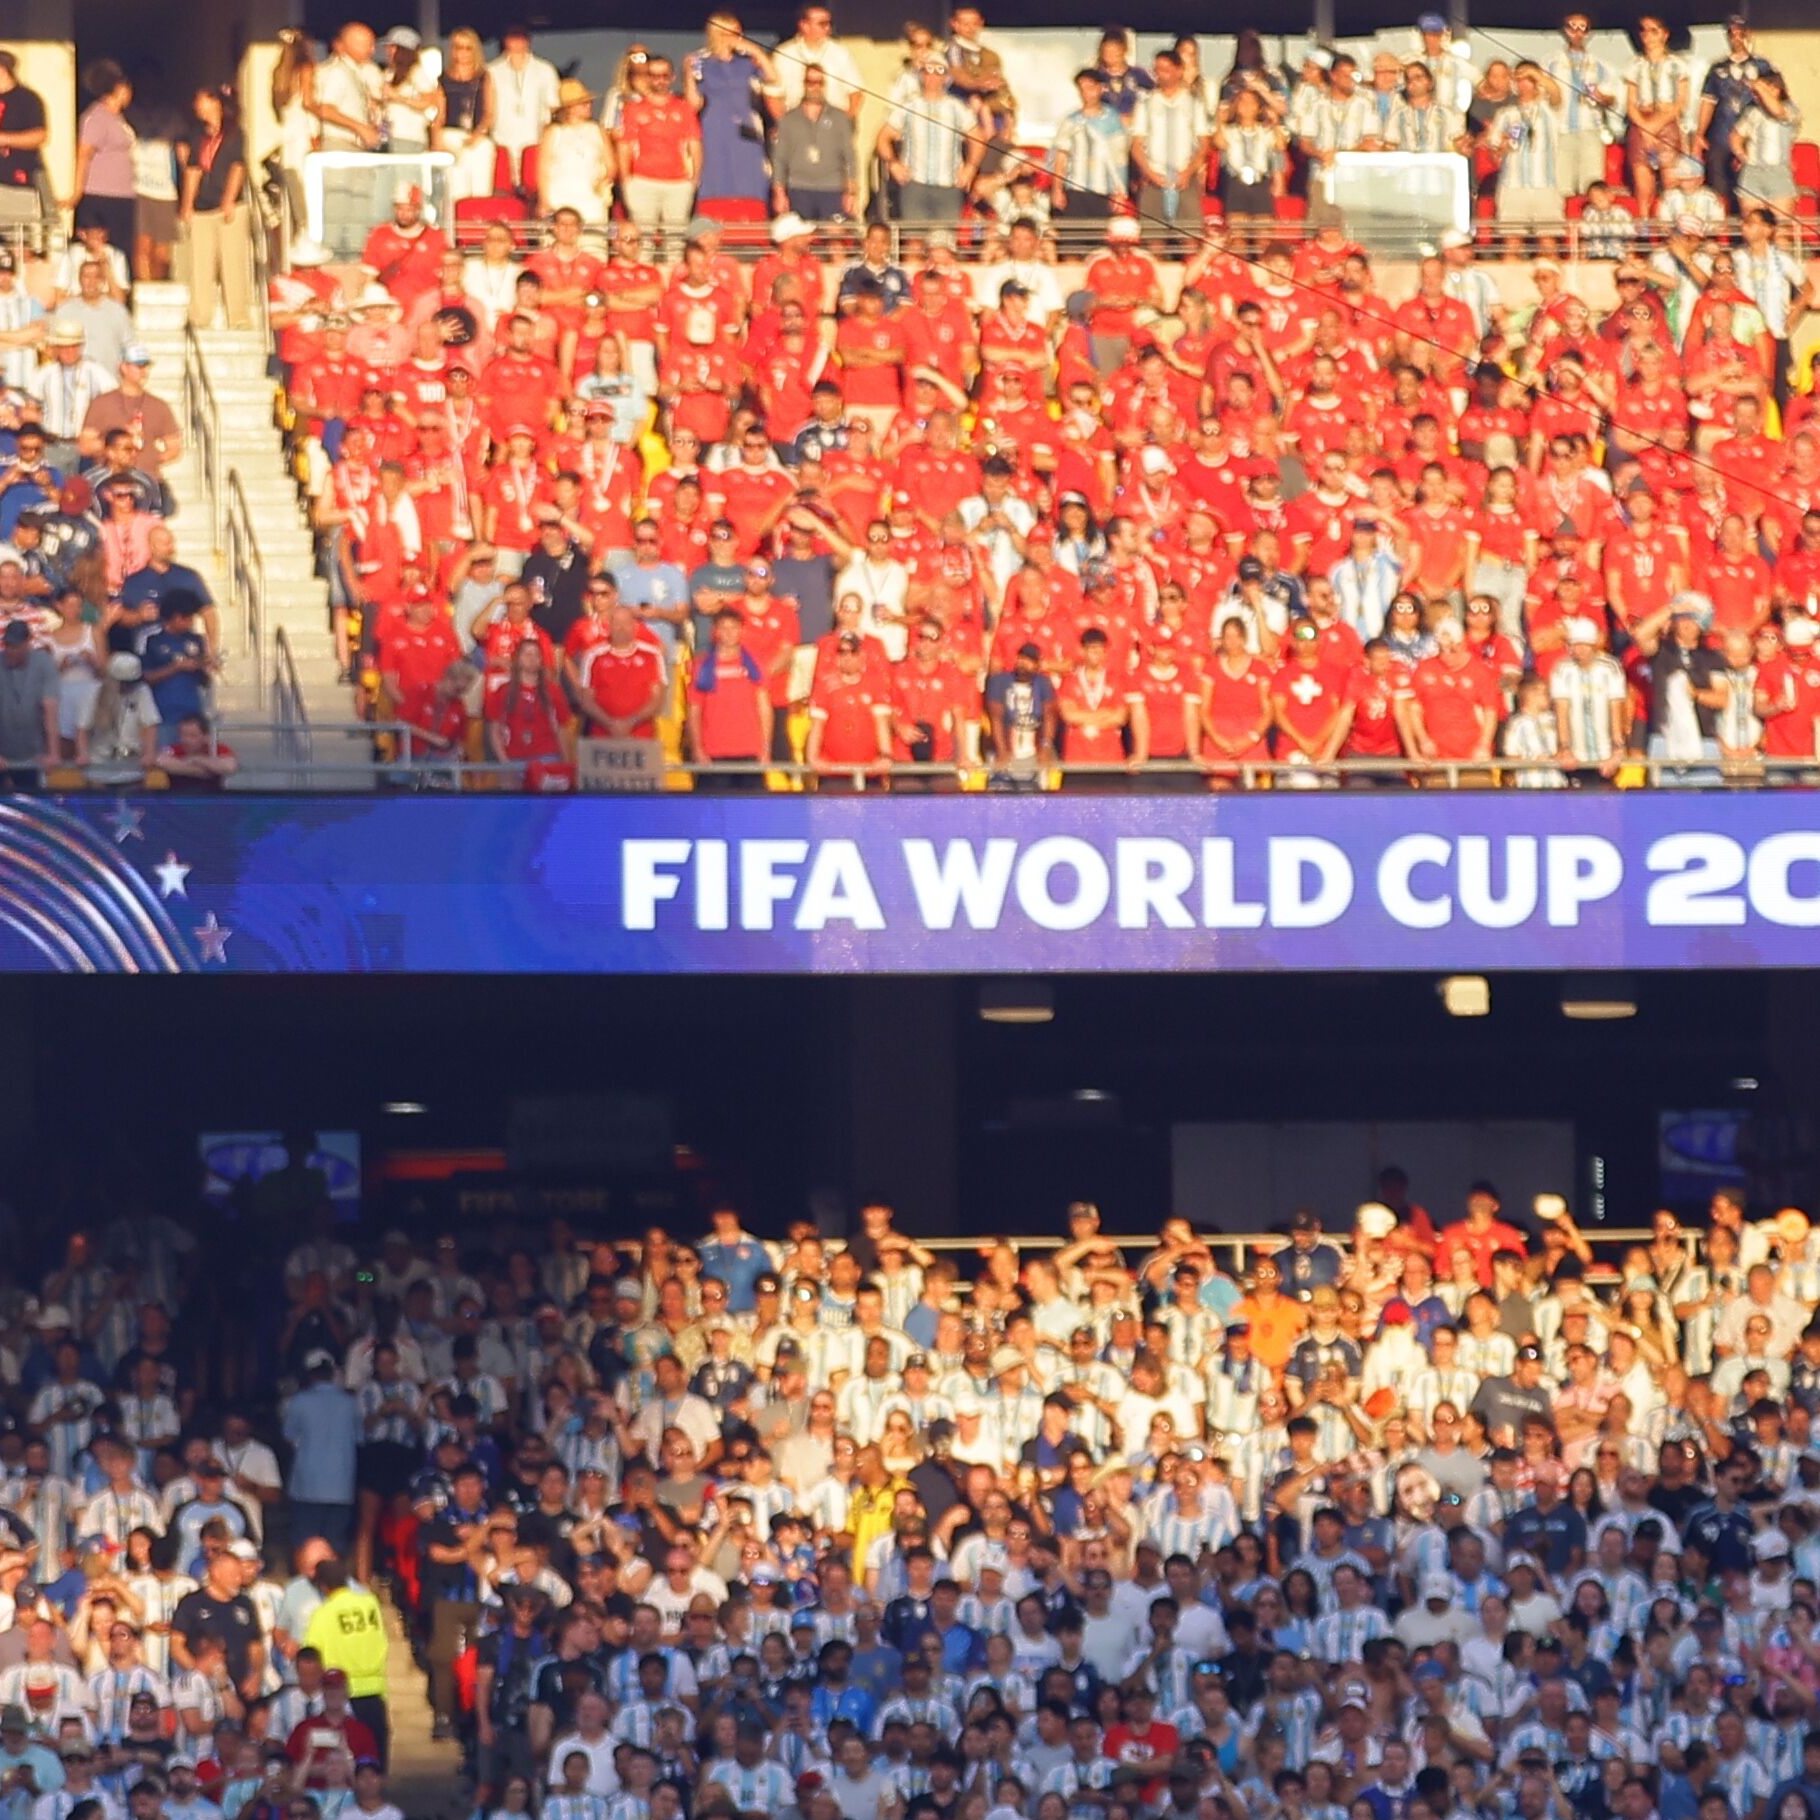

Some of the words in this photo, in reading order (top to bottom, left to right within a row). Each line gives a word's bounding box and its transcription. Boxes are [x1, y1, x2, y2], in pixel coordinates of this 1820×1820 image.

[622, 837, 887, 933] FIFA
[901, 834, 1354, 932] WORLD
[1376, 833, 1625, 930] CUP
